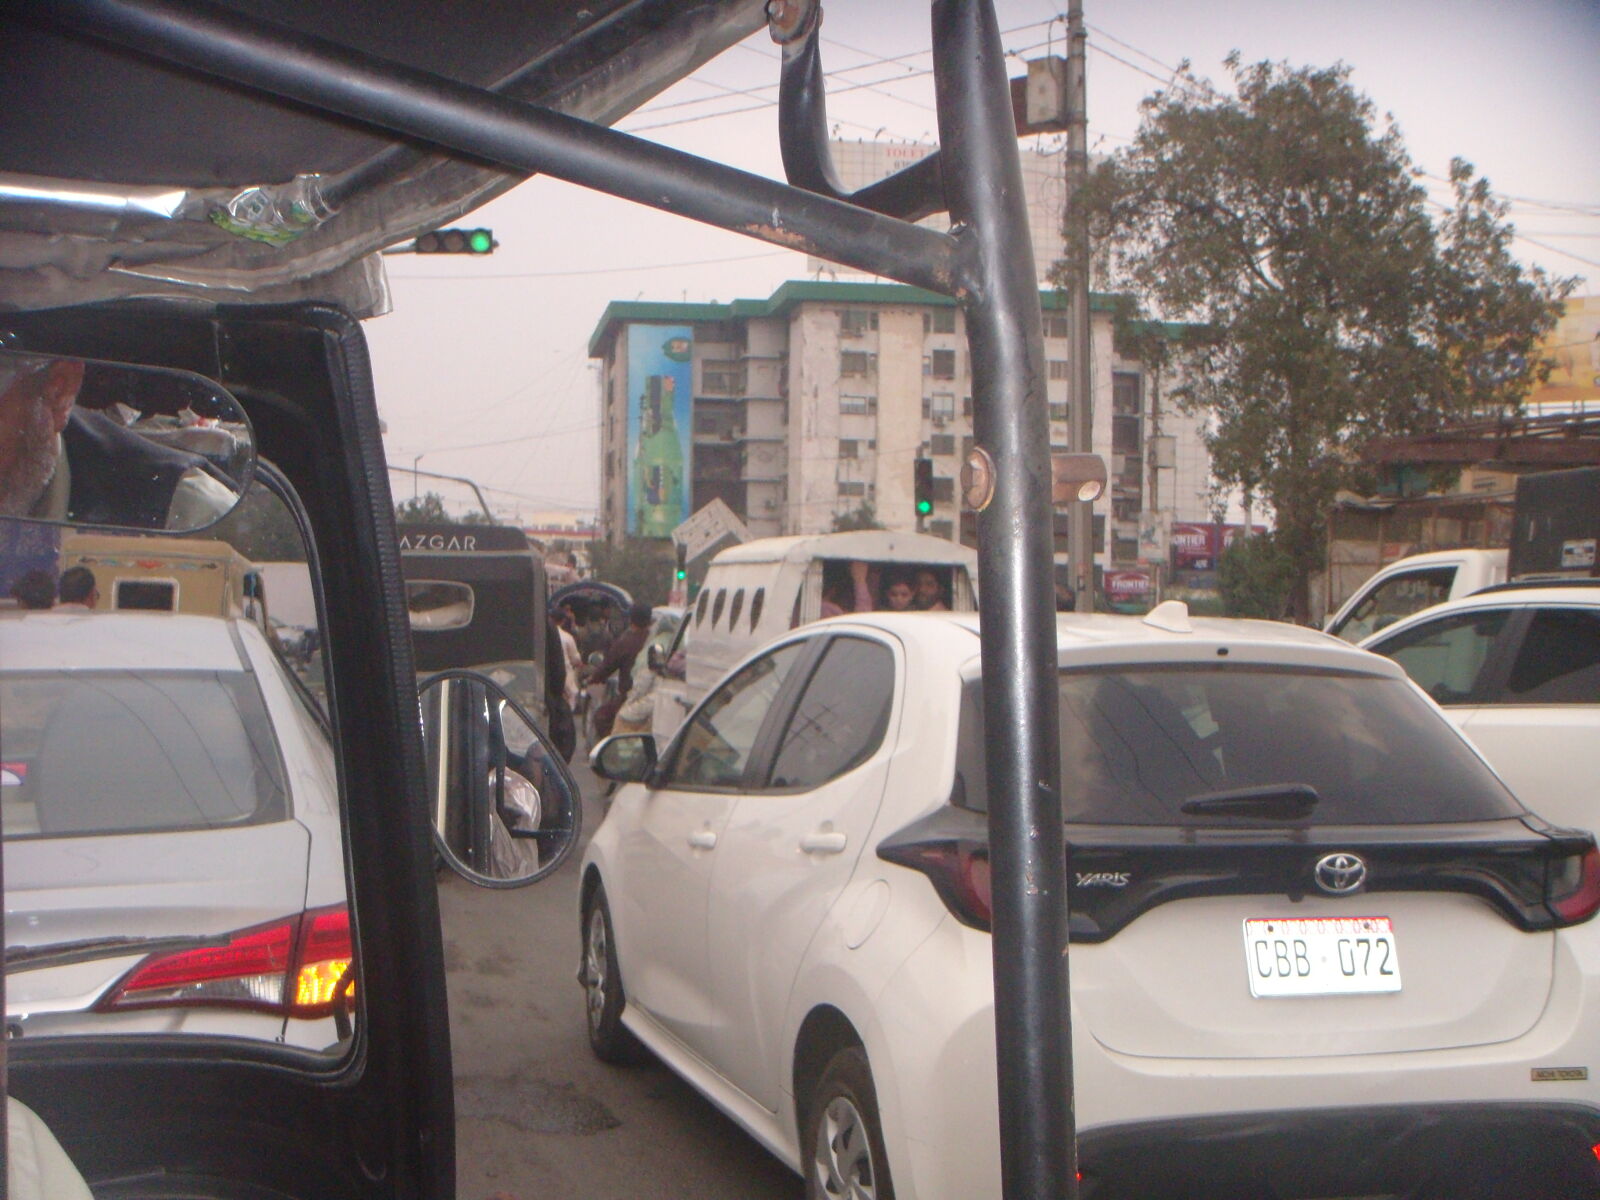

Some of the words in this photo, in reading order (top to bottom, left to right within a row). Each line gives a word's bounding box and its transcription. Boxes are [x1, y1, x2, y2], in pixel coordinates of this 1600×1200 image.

[400, 535, 476, 550] AZGAR
[1075, 872, 1131, 886] YARIS
[1255, 939, 1310, 977] CBB
[1338, 938, 1393, 976] 072
